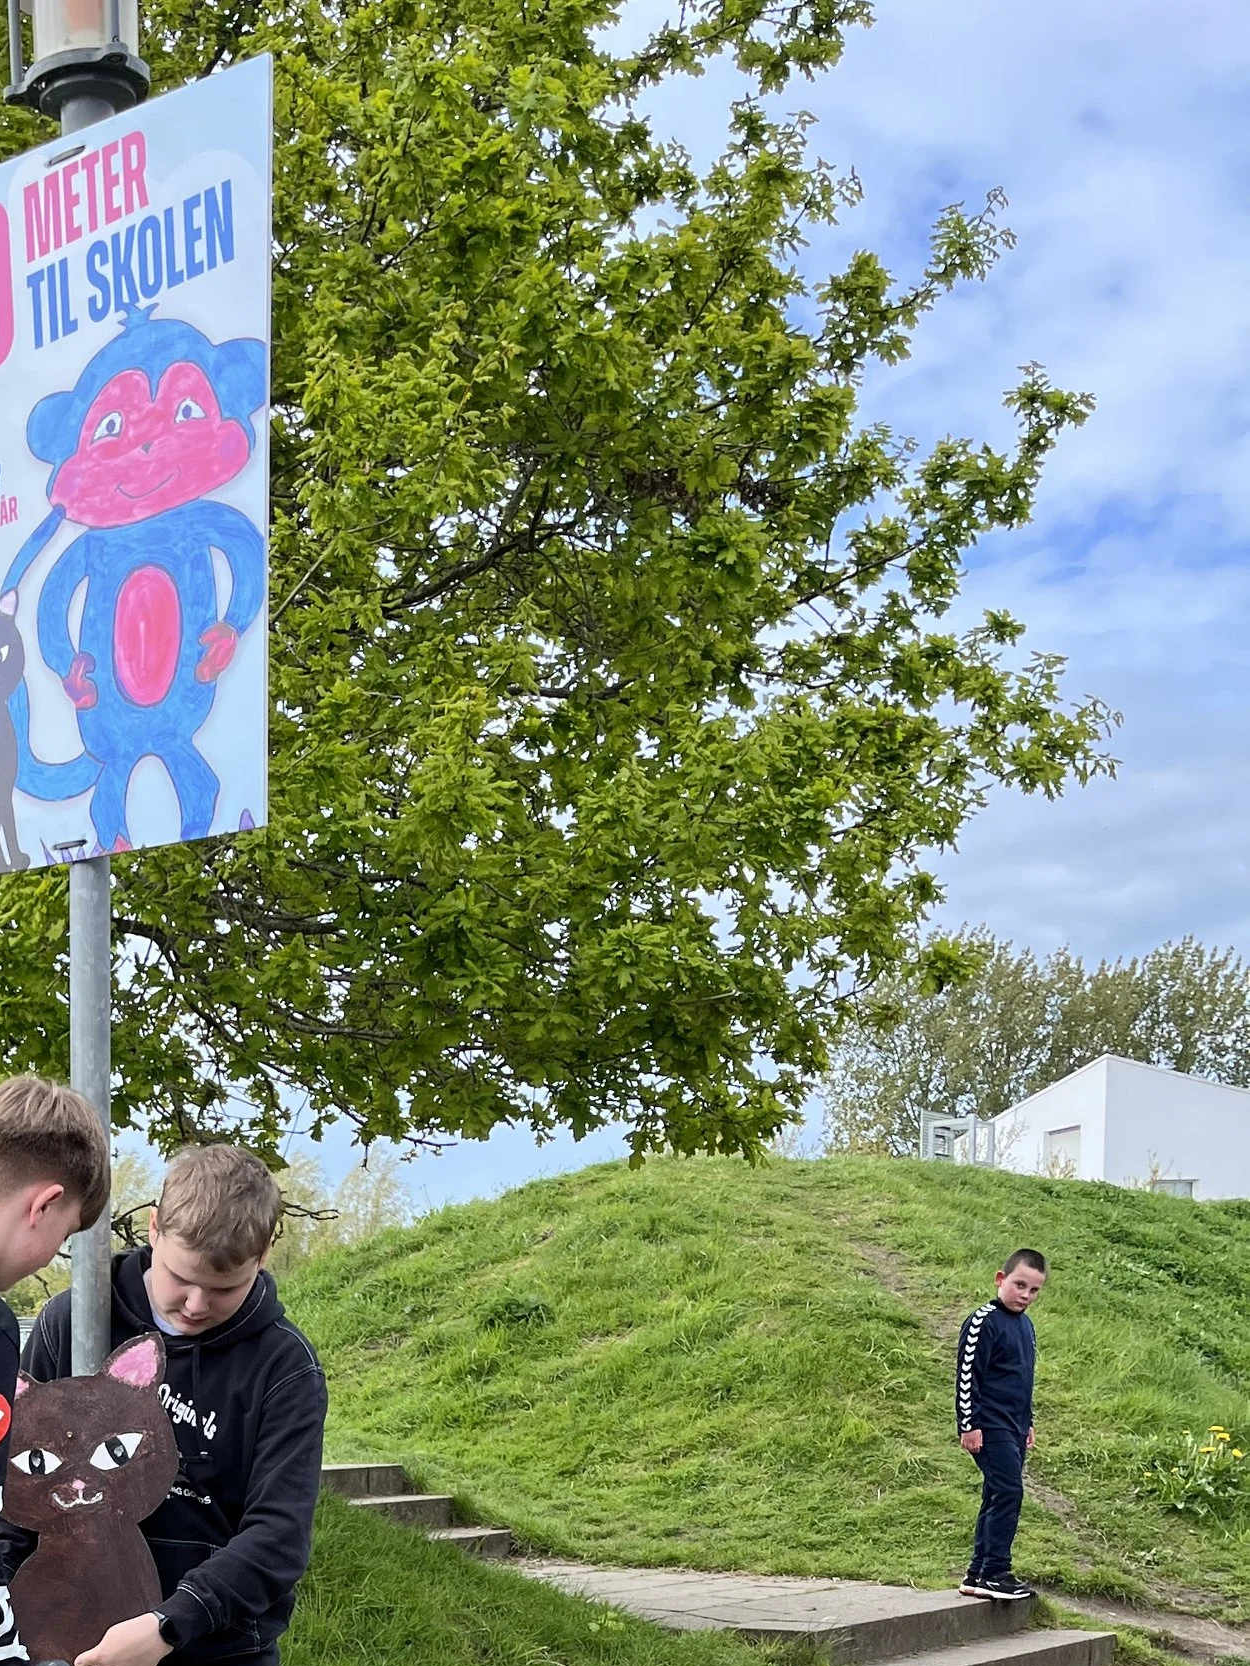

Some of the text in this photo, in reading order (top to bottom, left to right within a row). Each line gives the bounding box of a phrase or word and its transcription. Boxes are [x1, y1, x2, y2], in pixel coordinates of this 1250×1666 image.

[23, 131, 149, 263] METER
[26, 178, 235, 350] TIL SKOLEN
[157, 1383, 217, 1440] Originls
